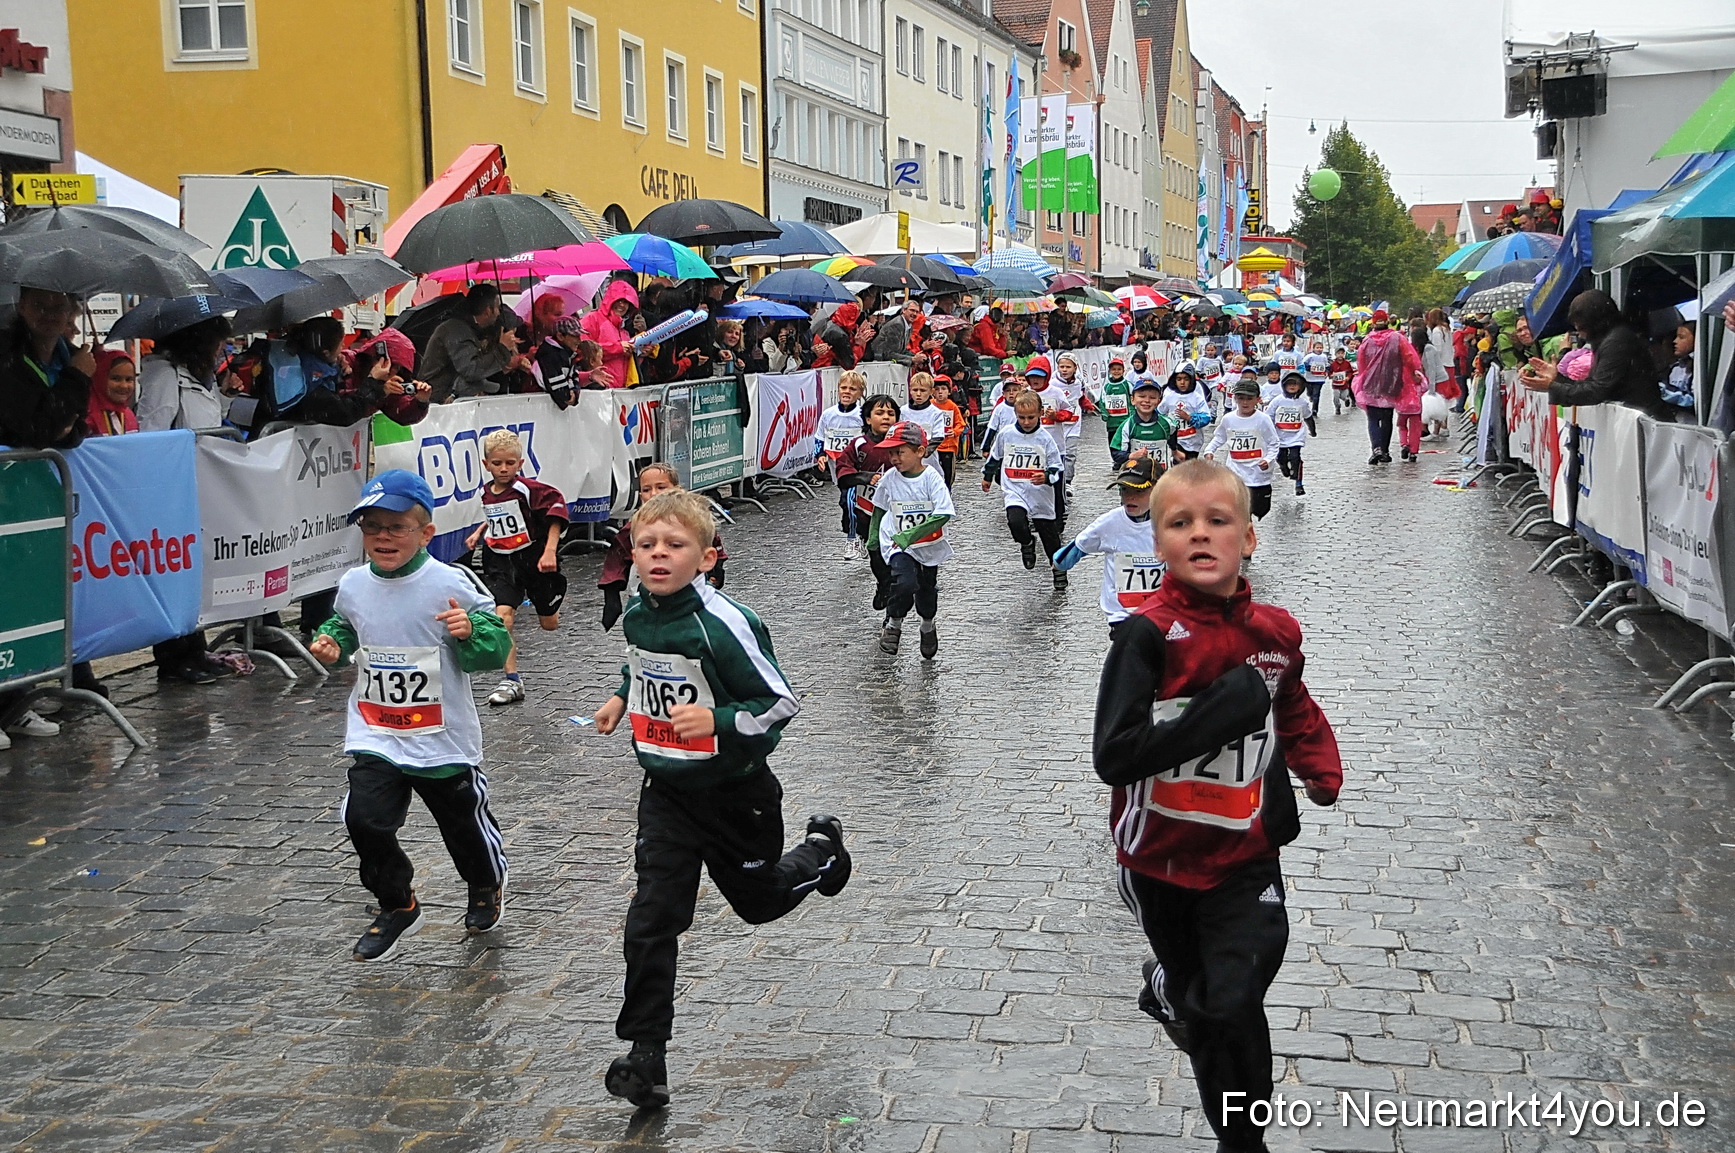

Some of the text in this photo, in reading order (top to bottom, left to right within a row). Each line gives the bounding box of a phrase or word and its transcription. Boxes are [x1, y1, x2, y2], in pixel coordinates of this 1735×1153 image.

[641, 165, 670, 200] CAFE
[1228, 385, 1237, 393] 72
[1108, 400, 1125, 409] 7052
[1279, 412, 1301, 422] 7254
[693, 425, 703, 440] Fun
[707, 422, 721, 437] Action
[828, 437, 850, 450] 723
[1230, 437, 1257, 451] 7347
[1008, 454, 1041, 469] 7074
[1148, 450, 1163, 463] 13
[861, 485, 876, 500] 72
[489, 515, 519, 537] 219
[896, 513, 933, 534] 732
[213, 536, 239, 561] Ihr
[302, 518, 314, 540] 2x
[315, 515, 324, 537] in
[326, 512, 350, 535] Neuma
[267, 575, 288, 591] Partner
[1165, 631, 1191, 641] adidas
[369, 652, 406, 663] BOCK
[641, 658, 672, 673] BOCK
[364, 668, 430, 704] 7132
[636, 674, 698, 720] 7062
[379, 710, 412, 726] Jonas
[1259, 894, 1280, 903] adidas
